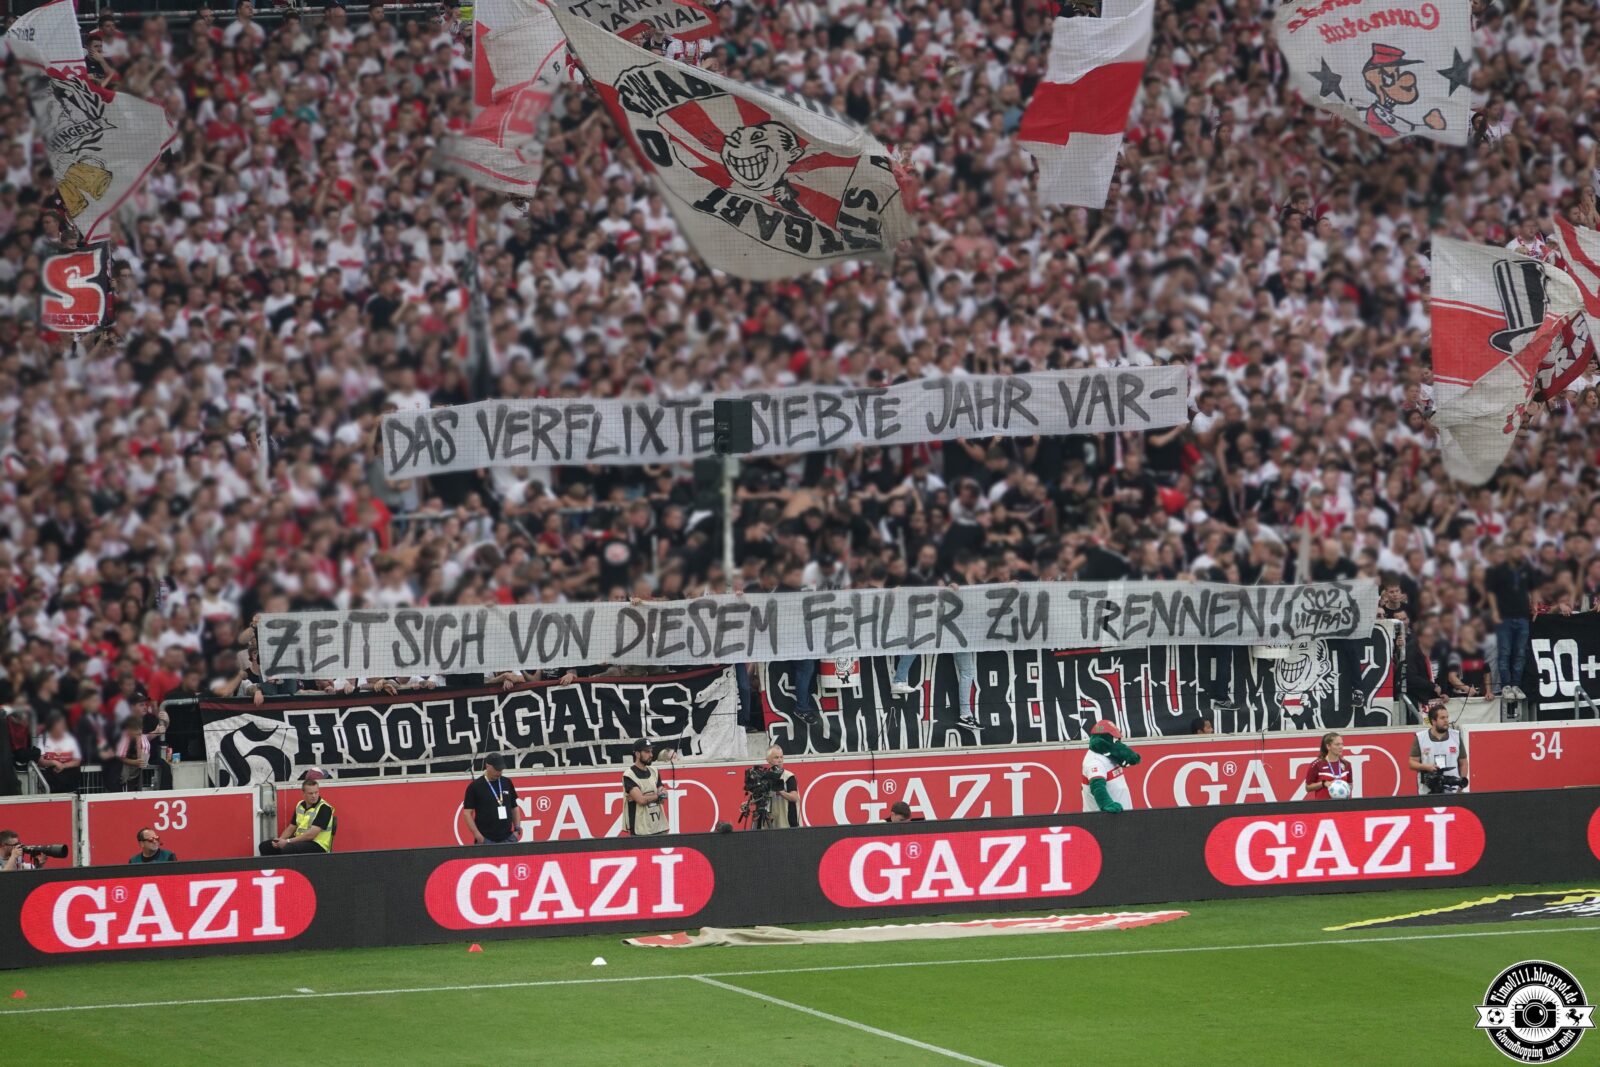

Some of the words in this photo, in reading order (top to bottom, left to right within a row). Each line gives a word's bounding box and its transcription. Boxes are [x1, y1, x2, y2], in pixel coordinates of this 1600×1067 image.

[386, 410, 459, 475] DAS
[477, 400, 714, 462] VERFLIXTE
[742, 387, 901, 450] SIEBTE
[922, 375, 1039, 435] JAHR
[1058, 373, 1178, 428] VAR-
[265, 612, 389, 676] ZEIT
[392, 608, 489, 670] SICH
[509, 607, 595, 665] VON
[612, 598, 778, 658] DIESEM
[802, 589, 967, 654] FEHLER
[985, 587, 1050, 643] ZU
[1068, 587, 1285, 641] TRENNEN!
[1295, 607, 1353, 634] ULTRAS
[284, 683, 694, 765] HOOLIGANS
[1531, 731, 1563, 761] 34
[154, 800, 188, 831] 33
[650, 812, 660, 822] TV
